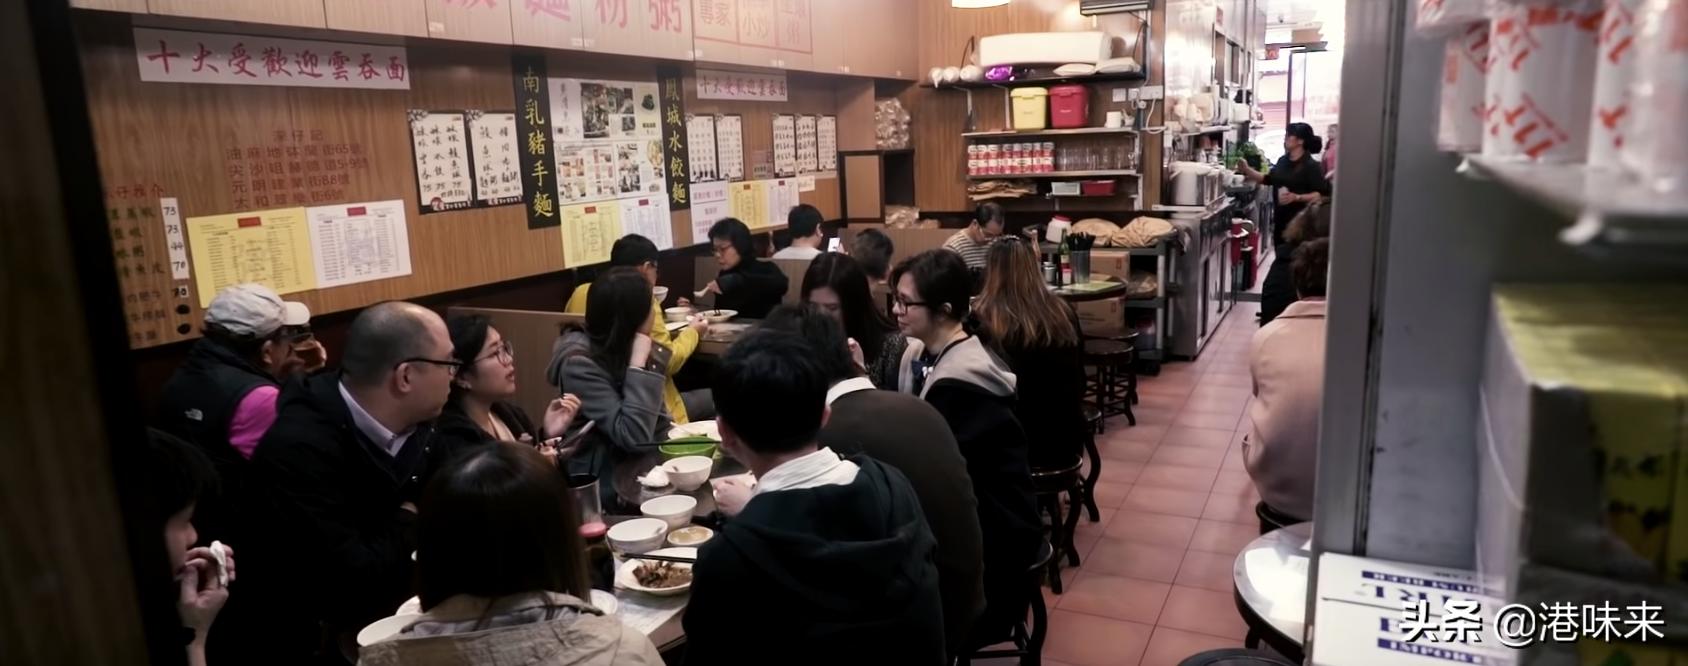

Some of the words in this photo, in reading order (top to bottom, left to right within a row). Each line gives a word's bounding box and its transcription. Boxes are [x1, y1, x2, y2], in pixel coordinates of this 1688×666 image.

[147, 40, 405, 81] 十大受歡迎雲吞面
[522, 66, 554, 217] 南乳豬手麵
